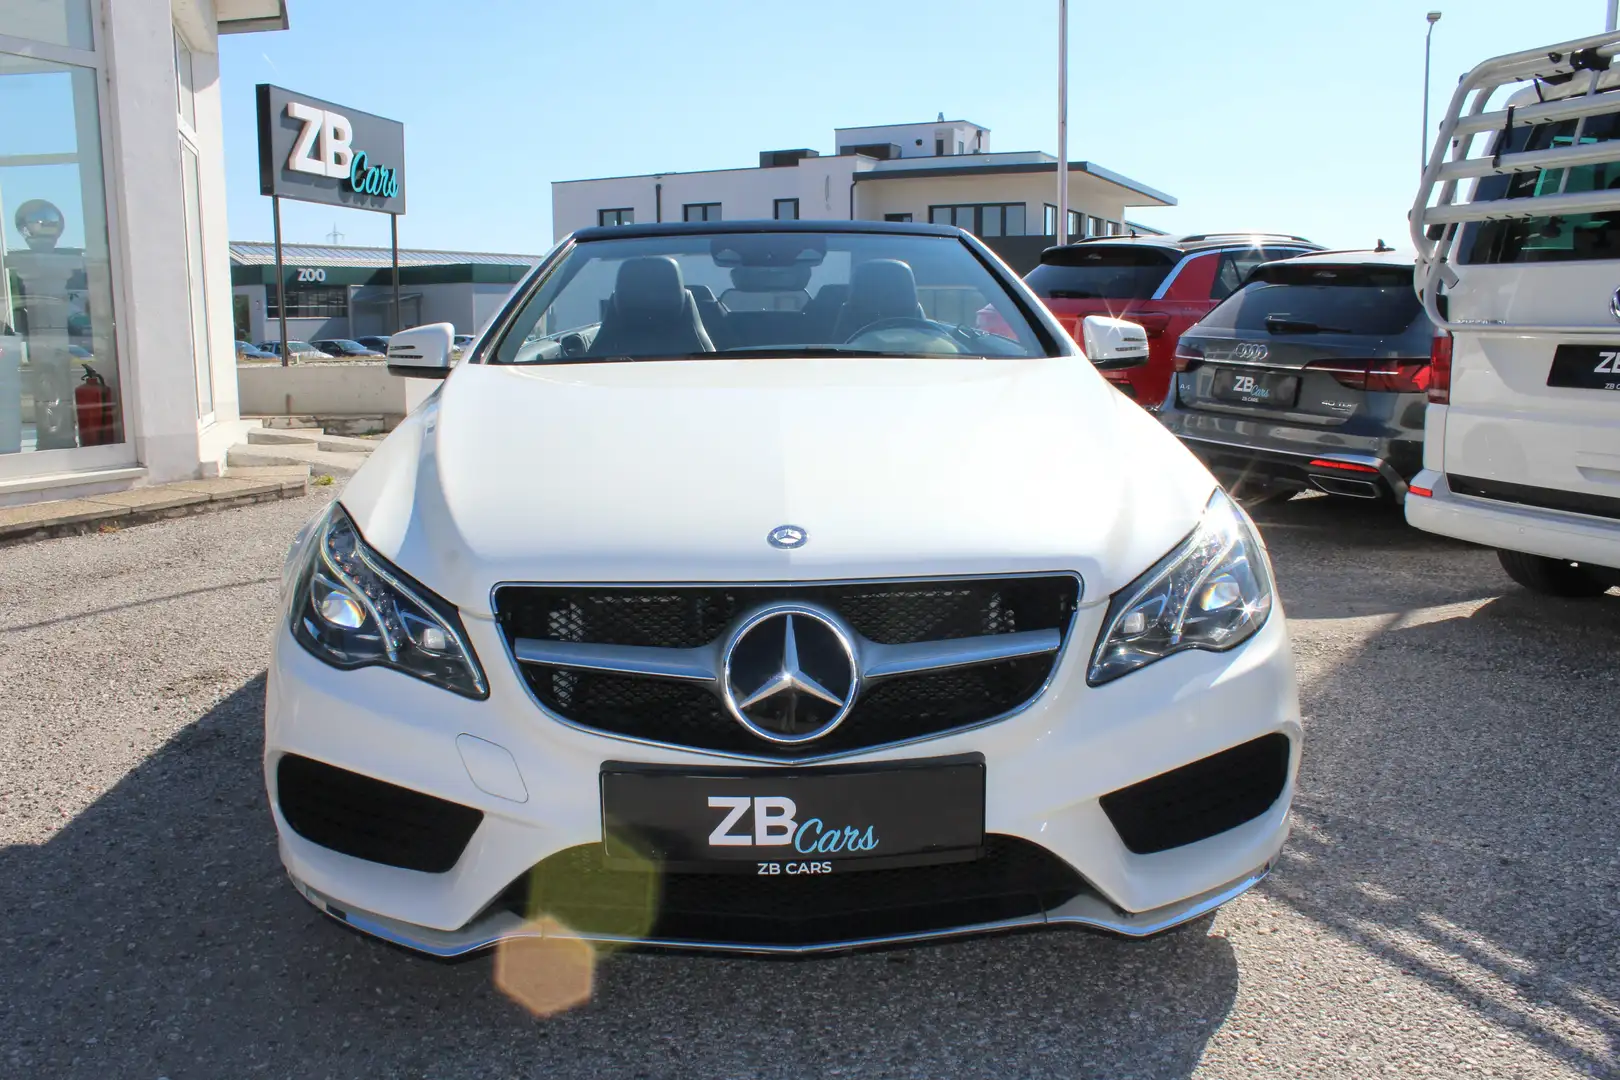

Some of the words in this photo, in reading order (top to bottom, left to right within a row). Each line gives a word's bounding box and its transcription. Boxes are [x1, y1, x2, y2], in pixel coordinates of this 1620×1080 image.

[287, 102, 354, 179] ZB
[351, 150, 398, 198] Cars
[297, 268, 326, 282] ZOO
[1233, 375, 1254, 392] ZB
[1250, 384, 1270, 398] Cars
[708, 796, 798, 846] ZB
[795, 818, 879, 854] Cars
[757, 863, 781, 875] ZB
[786, 861, 832, 875] CARS
